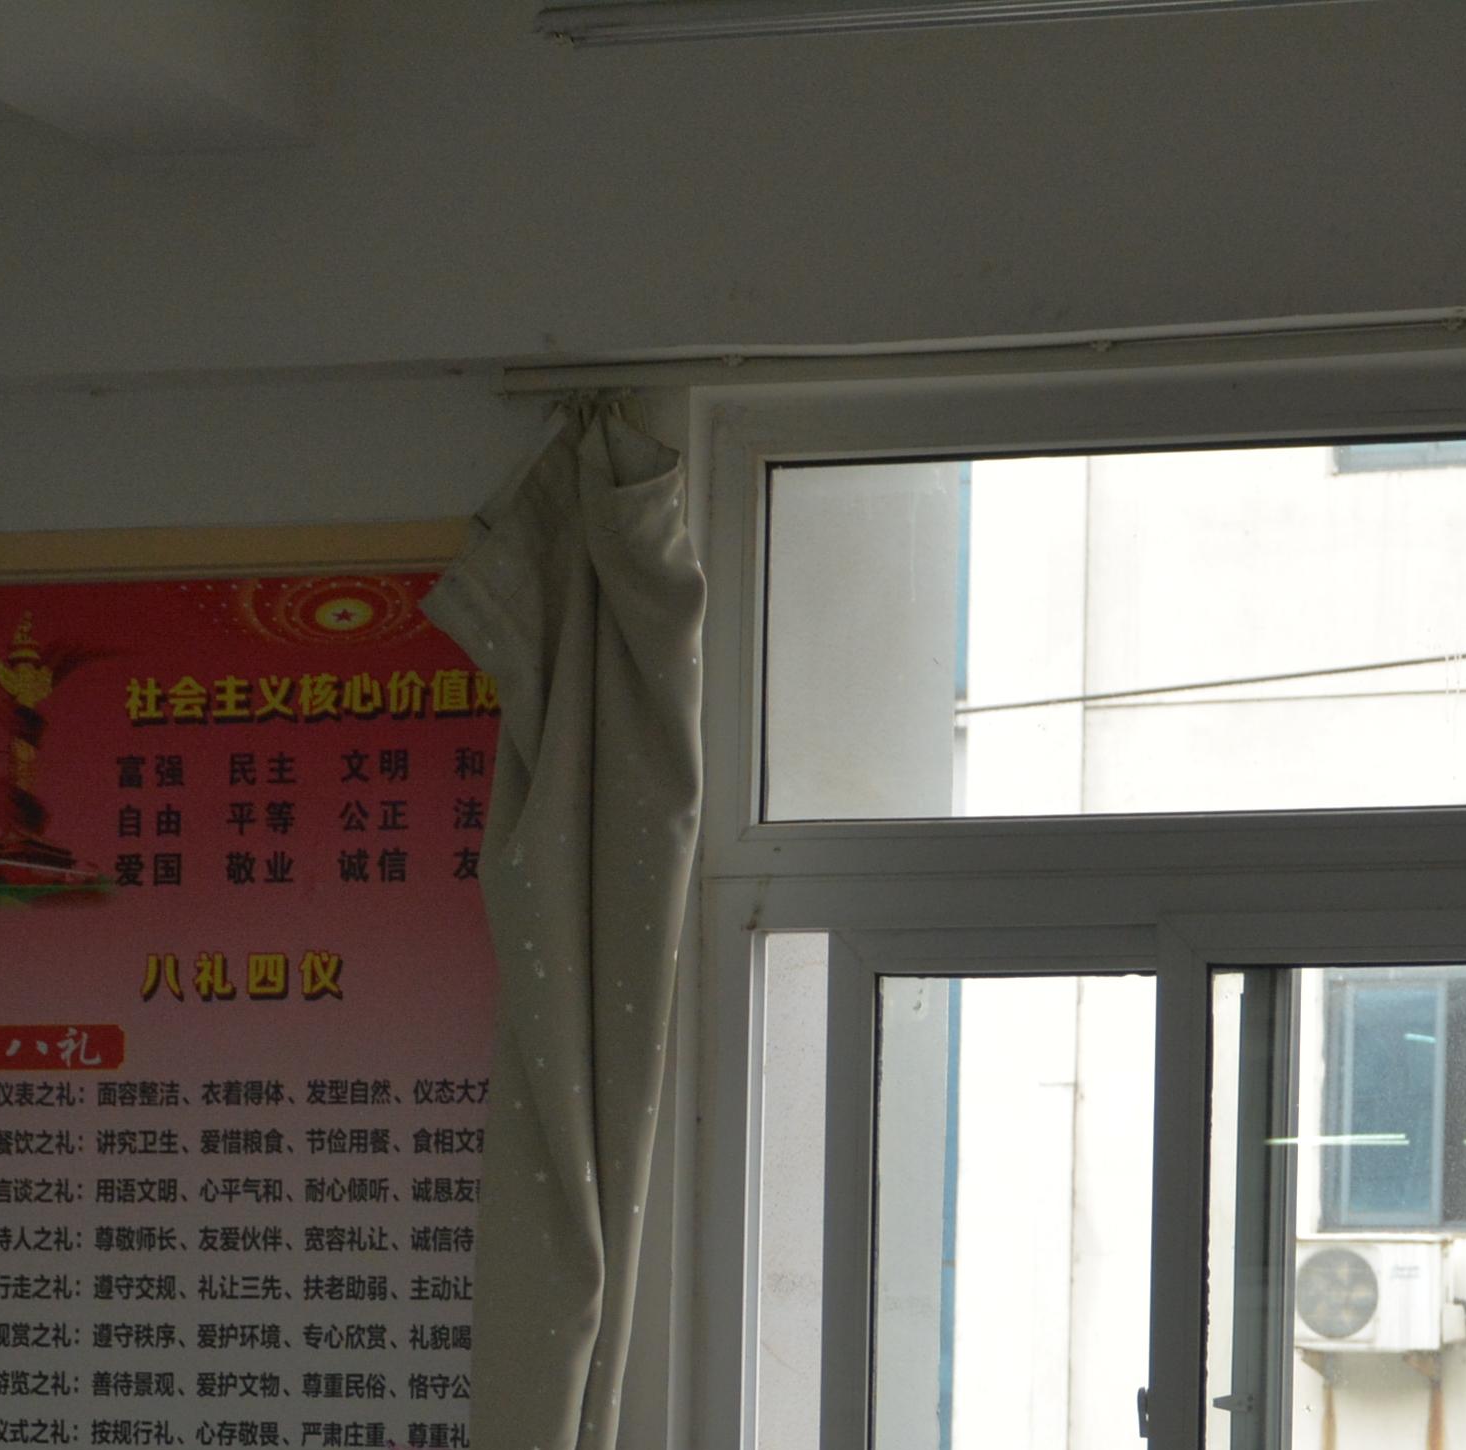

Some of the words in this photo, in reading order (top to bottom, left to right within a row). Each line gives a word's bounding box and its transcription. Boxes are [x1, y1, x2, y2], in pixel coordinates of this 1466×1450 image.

[116, 755, 184, 788] 富强
[230, 752, 296, 786] 民主
[340, 750, 409, 784] 文明
[455, 747, 484, 780] 和
[118, 805, 182, 838] 自由
[226, 802, 295, 836] 平等
[338, 800, 409, 832] 公正
[454, 797, 484, 830] 法
[115, 852, 182, 887] 爱国
[226, 850, 294, 885] 敬业
[338, 849, 408, 882] 诚信
[454, 848, 480, 880] 友
[139, 950, 343, 999] 八礼四仪
[5, 1027, 102, 1067] 八礼
